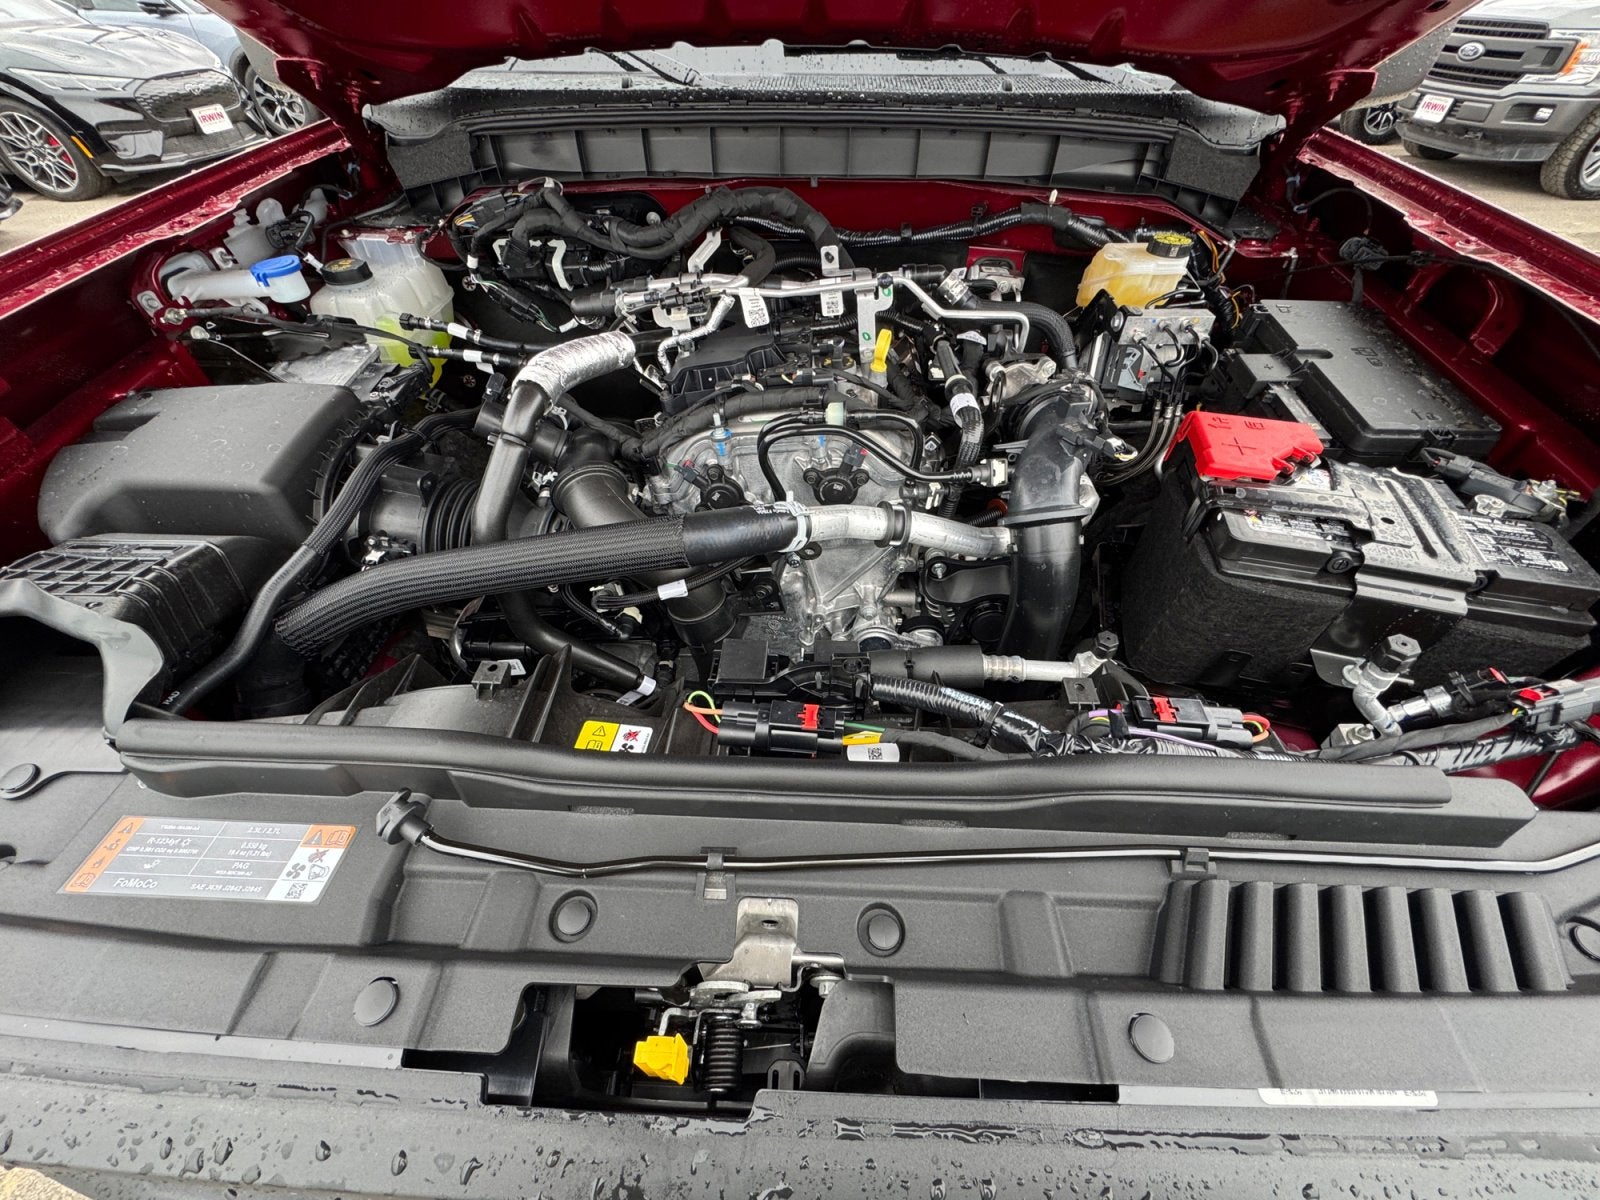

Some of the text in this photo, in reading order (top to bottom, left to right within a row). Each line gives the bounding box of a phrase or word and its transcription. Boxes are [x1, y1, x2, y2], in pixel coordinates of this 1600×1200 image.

[1421, 101, 1447, 113] IRWIN
[198, 111, 225, 124] IRWIN
[113, 878, 158, 889] FoMoCo
